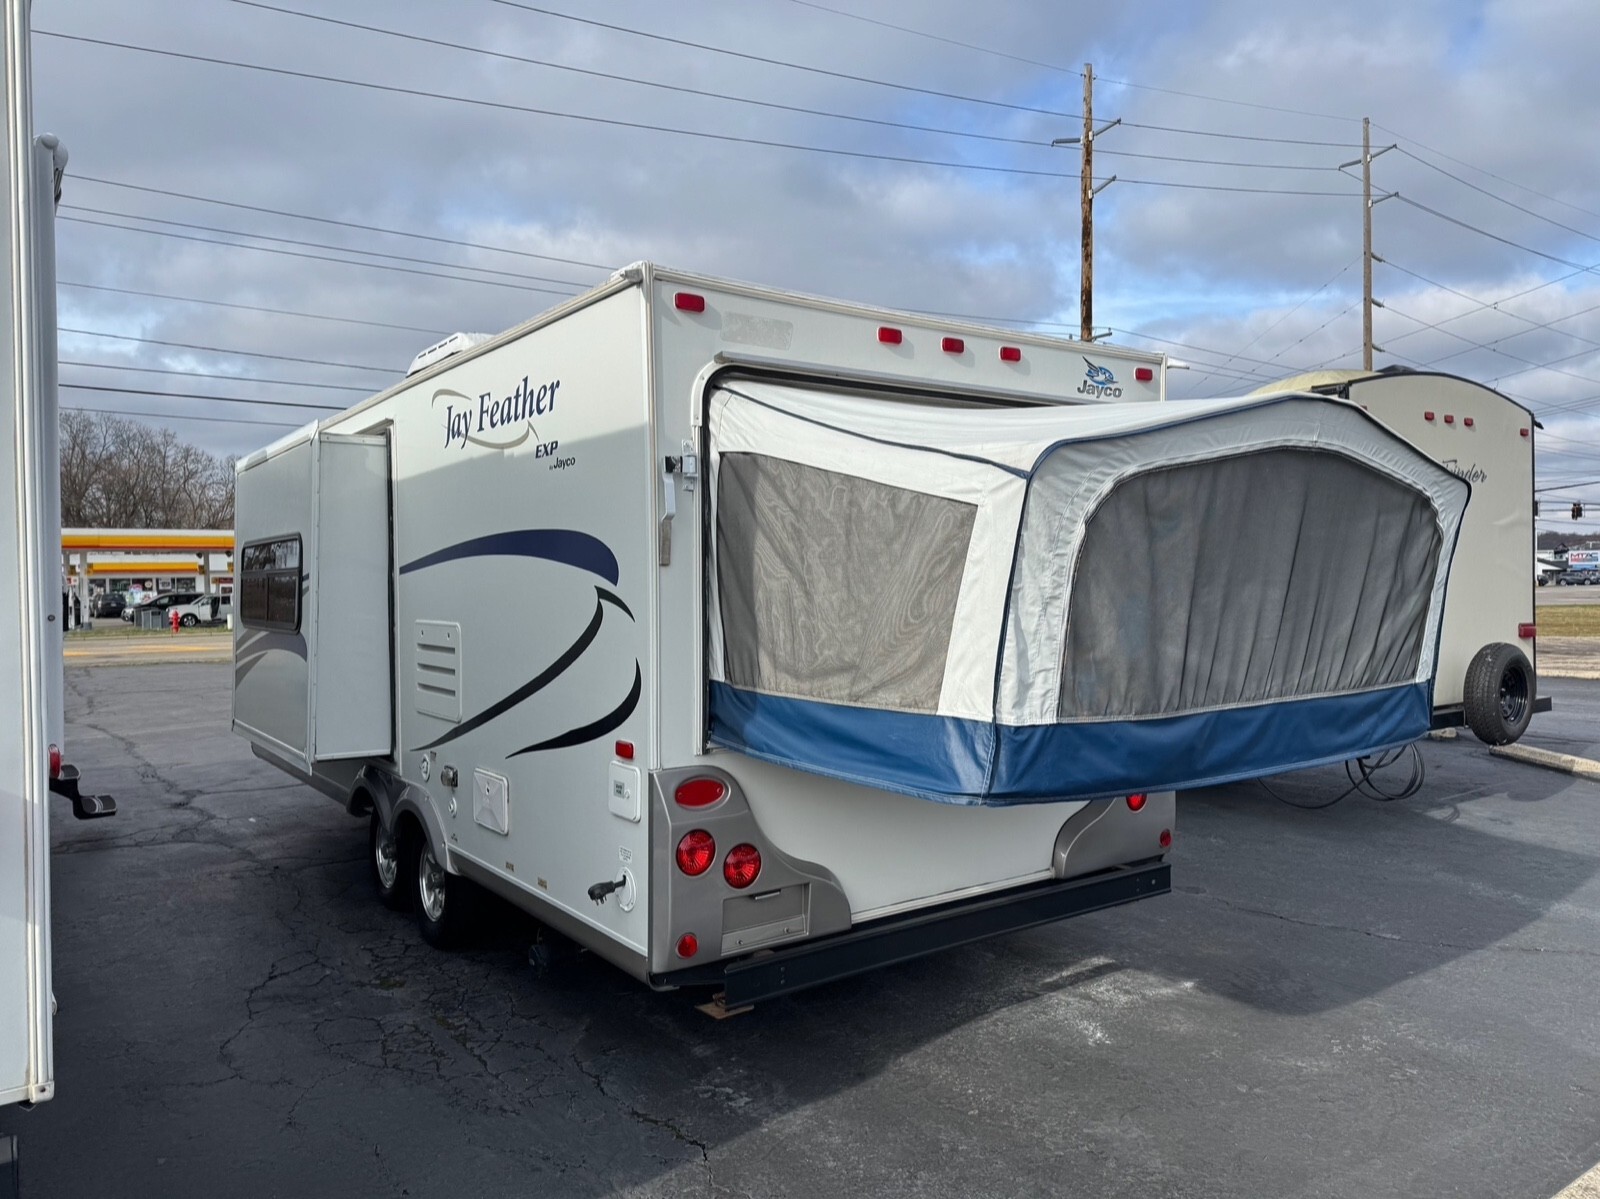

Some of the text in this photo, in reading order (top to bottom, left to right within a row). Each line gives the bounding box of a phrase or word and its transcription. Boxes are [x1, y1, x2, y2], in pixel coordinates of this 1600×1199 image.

[1077, 380, 1122, 398] Jayco
[445, 375, 560, 449] Jay Feather
[536, 441, 558, 459] EXP
[554, 457, 576, 470] Jayco
